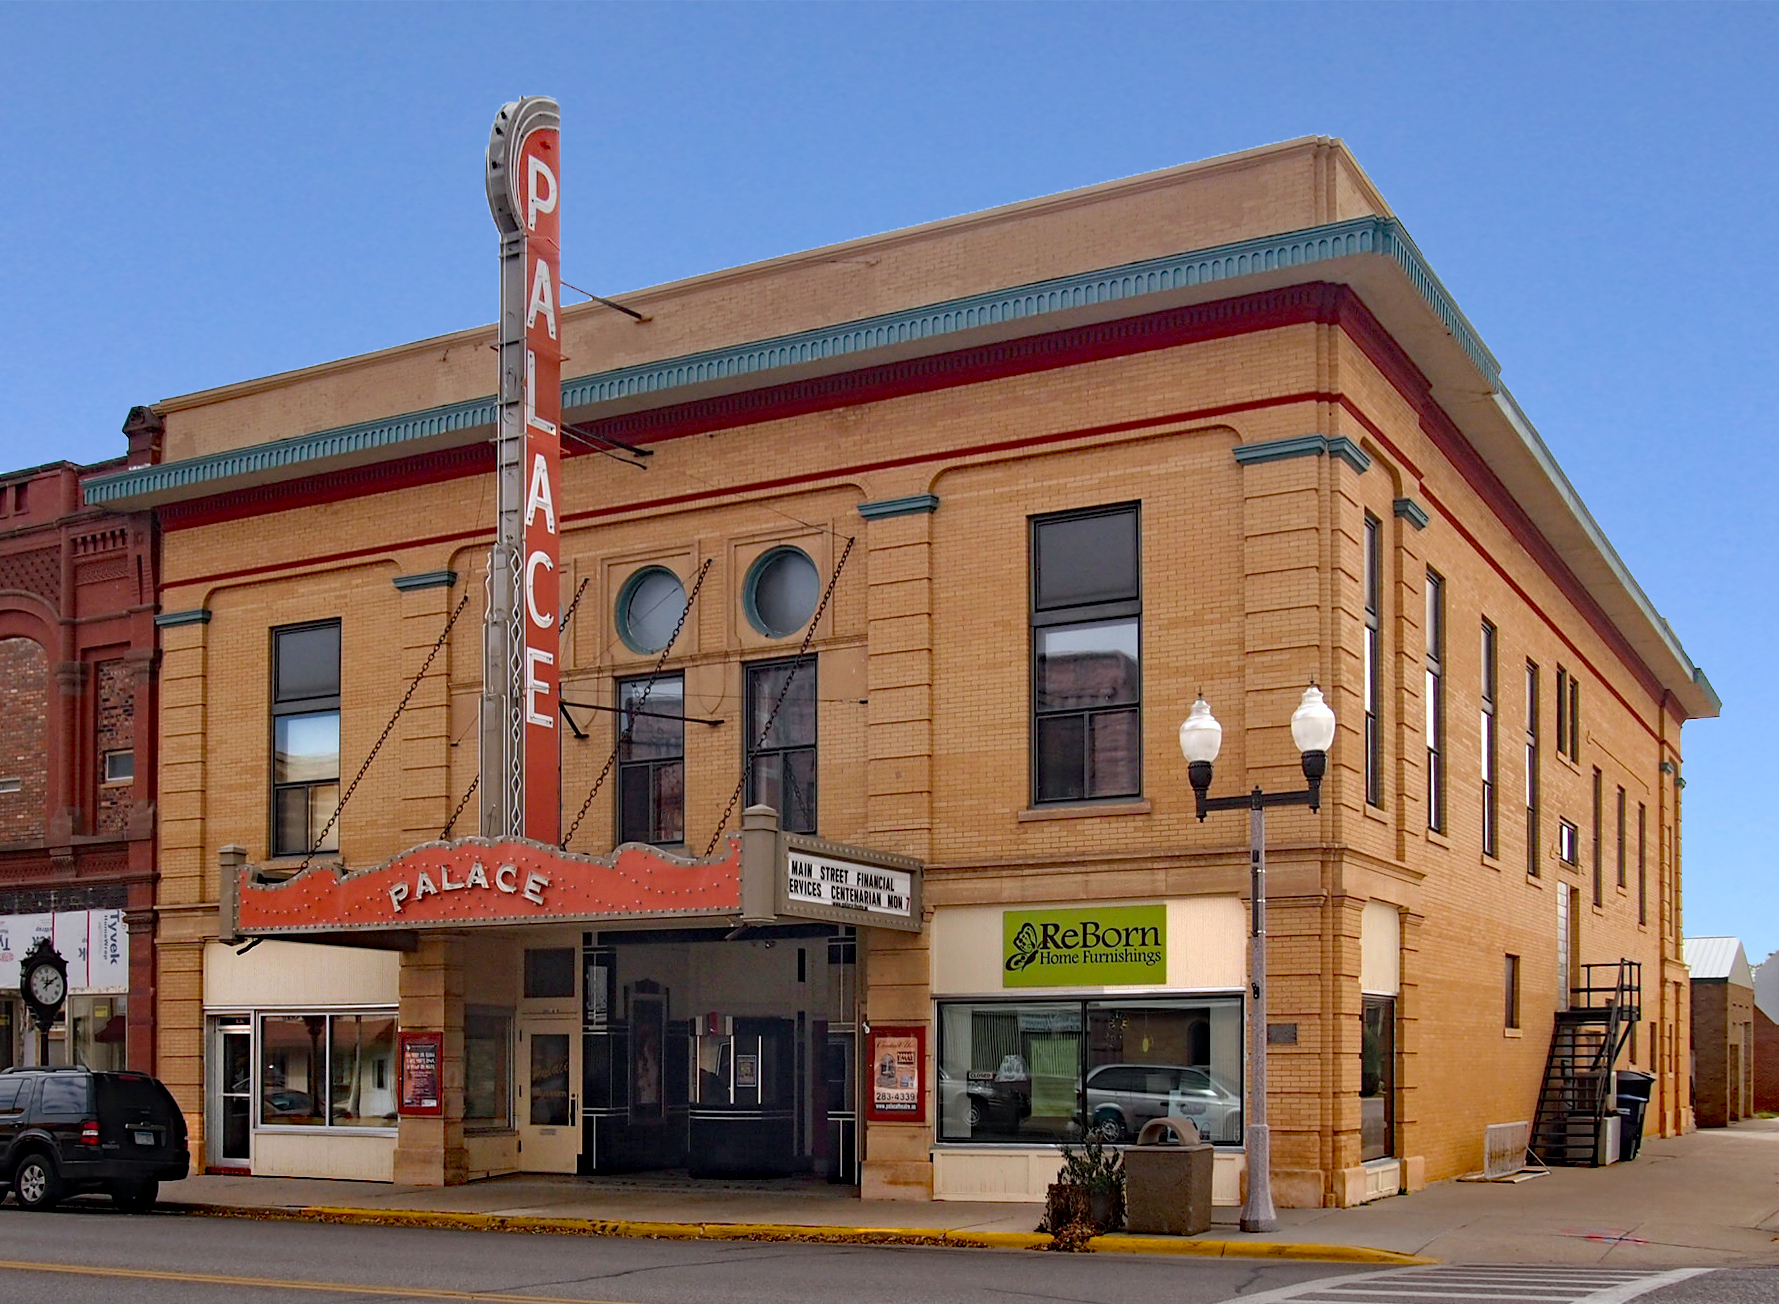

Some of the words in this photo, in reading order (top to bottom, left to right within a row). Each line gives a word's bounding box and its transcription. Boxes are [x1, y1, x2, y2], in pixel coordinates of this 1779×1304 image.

[527, 154, 558, 728] PALACE
[388, 860, 550, 913] PALACE
[791, 860, 813, 878] MAIN
[820, 866, 849, 884] STREET
[856, 872, 895, 892] FINANCIAL
[830, 886, 882, 907] CENTENARIAN
[887, 894, 903, 910] MON
[108, 909, 120, 965] Tyvek
[1039, 921, 1162, 950] ReBorn
[1039, 950, 1079, 965] Home
[1083, 948, 1162, 967] Furnishings
